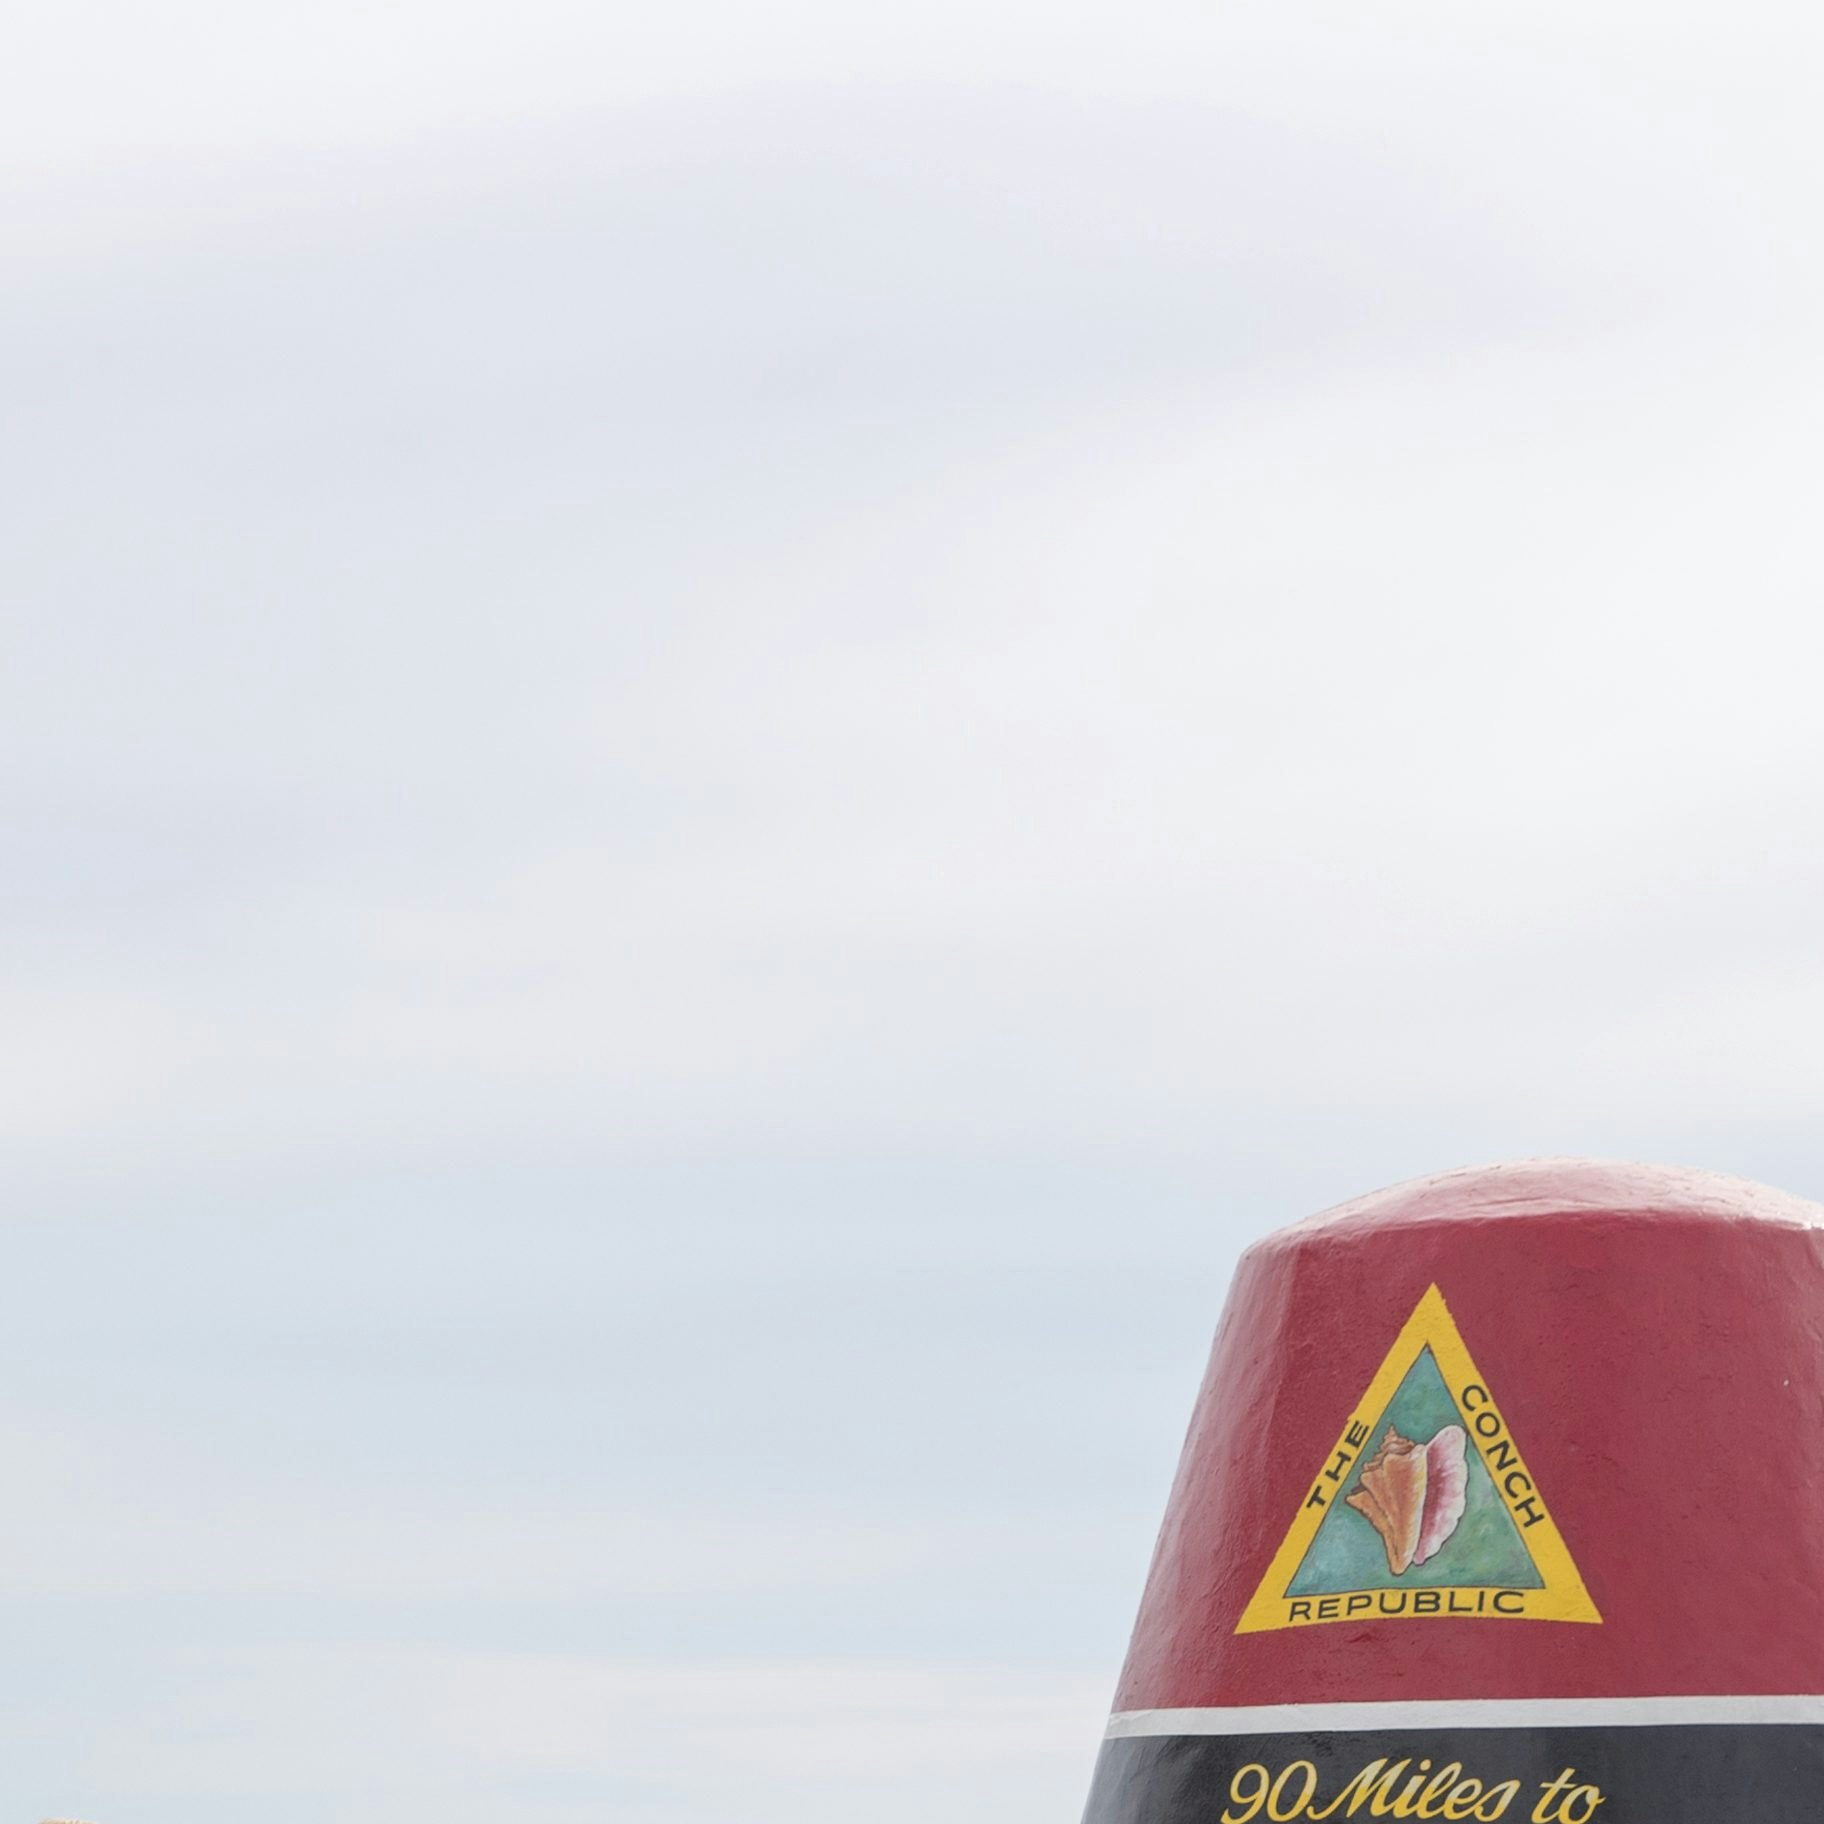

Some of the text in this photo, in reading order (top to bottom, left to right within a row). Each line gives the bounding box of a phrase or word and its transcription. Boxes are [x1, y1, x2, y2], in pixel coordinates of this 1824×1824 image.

[1306, 1419, 1370, 1511] THE
[1461, 1385, 1545, 1529] CONCH
[1288, 1591, 1525, 1622] REPUBLIC
[1307, 1757, 1521, 1823] Miles
